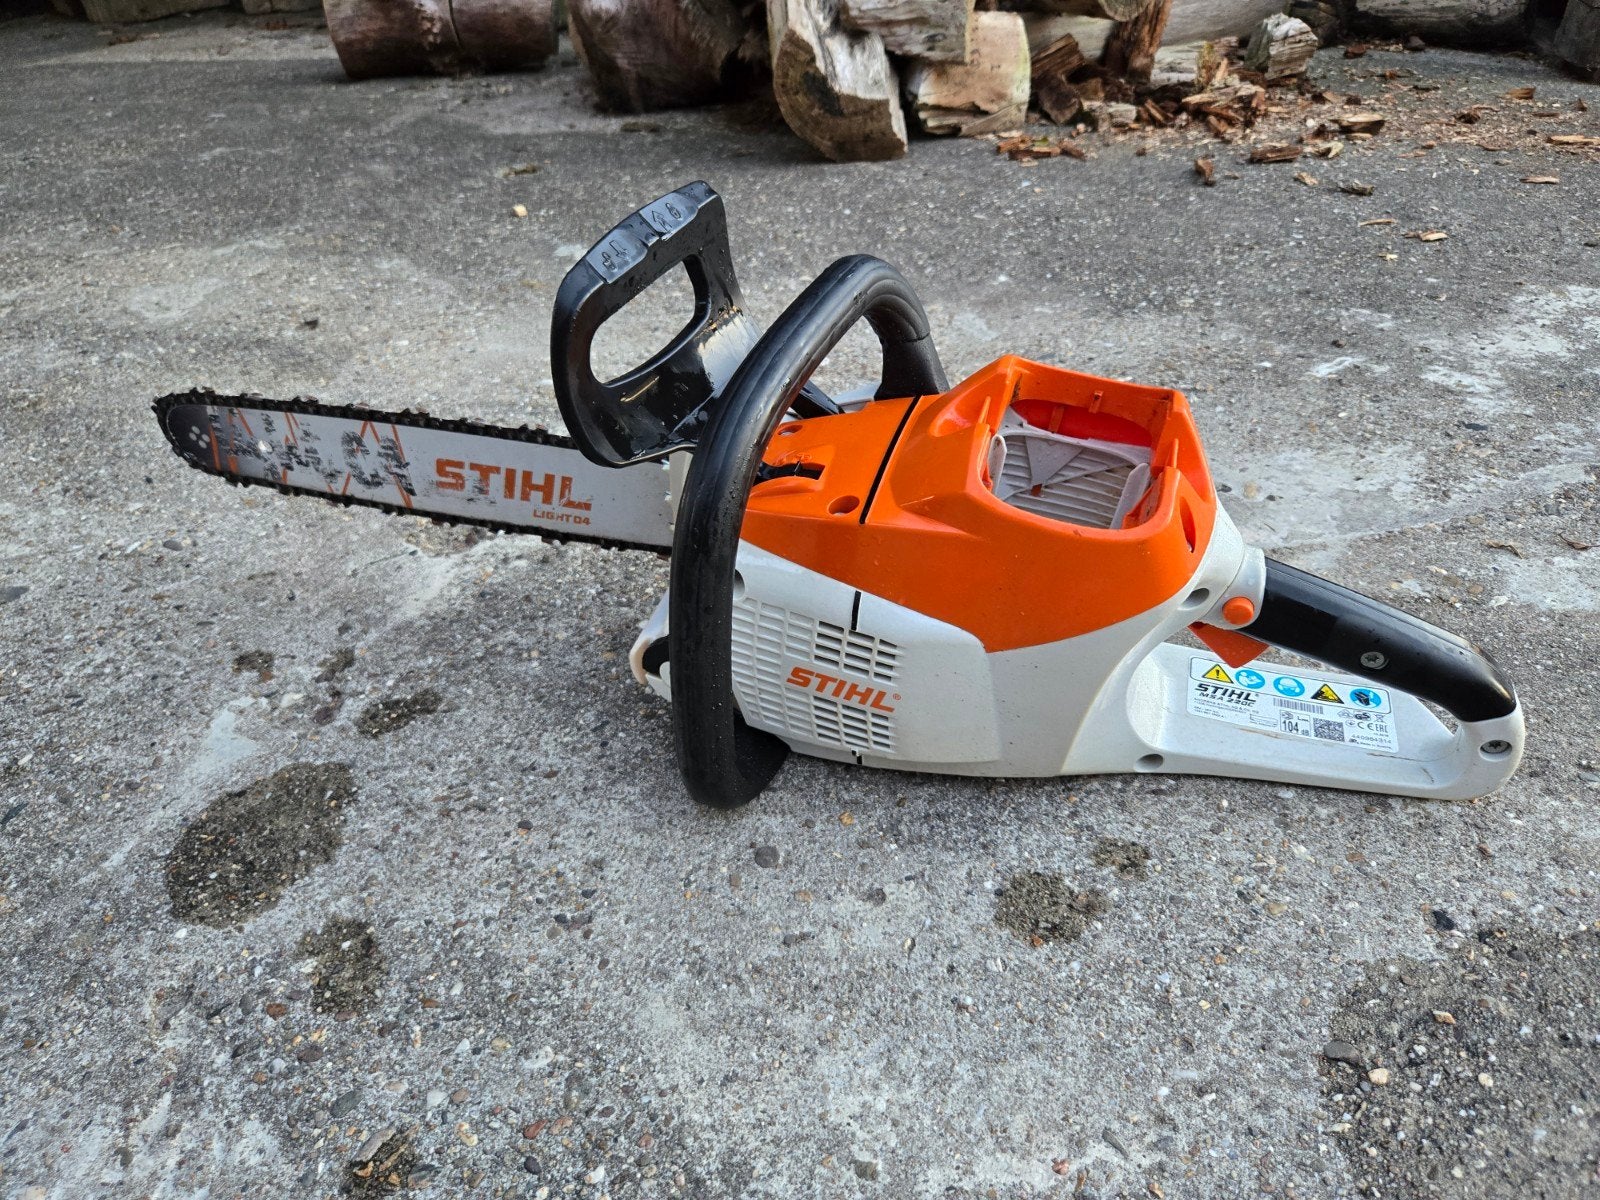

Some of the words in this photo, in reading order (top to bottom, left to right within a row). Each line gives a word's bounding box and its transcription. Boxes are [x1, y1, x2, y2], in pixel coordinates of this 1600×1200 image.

[436, 458, 592, 511] STIHL
[786, 666, 895, 713] STIHL
[1195, 683, 1257, 702] STIHL
[1282, 719, 1299, 732] 104
